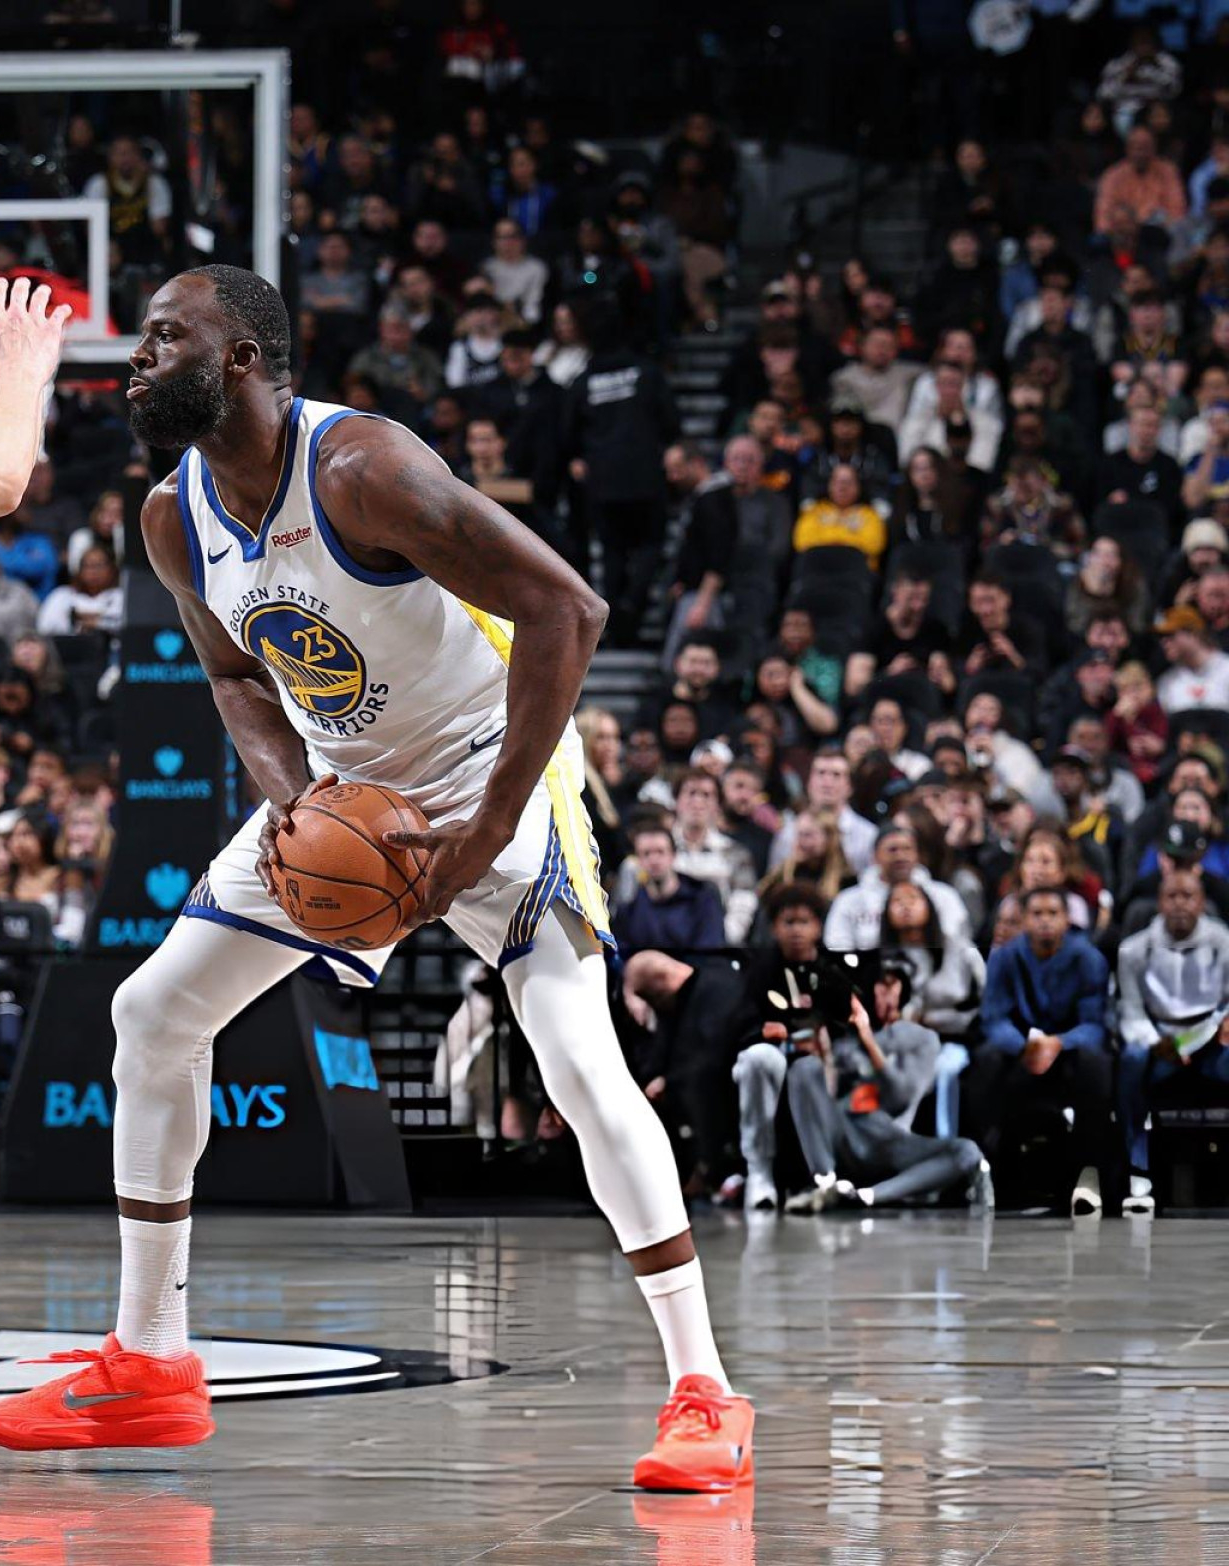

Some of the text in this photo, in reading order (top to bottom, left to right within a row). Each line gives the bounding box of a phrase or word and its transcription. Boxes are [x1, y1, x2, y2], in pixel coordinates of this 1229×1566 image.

[229, 584, 330, 633] GOLDEN STATE
[292, 625, 337, 663] 23
[306, 682, 390, 737] ARRIORS
